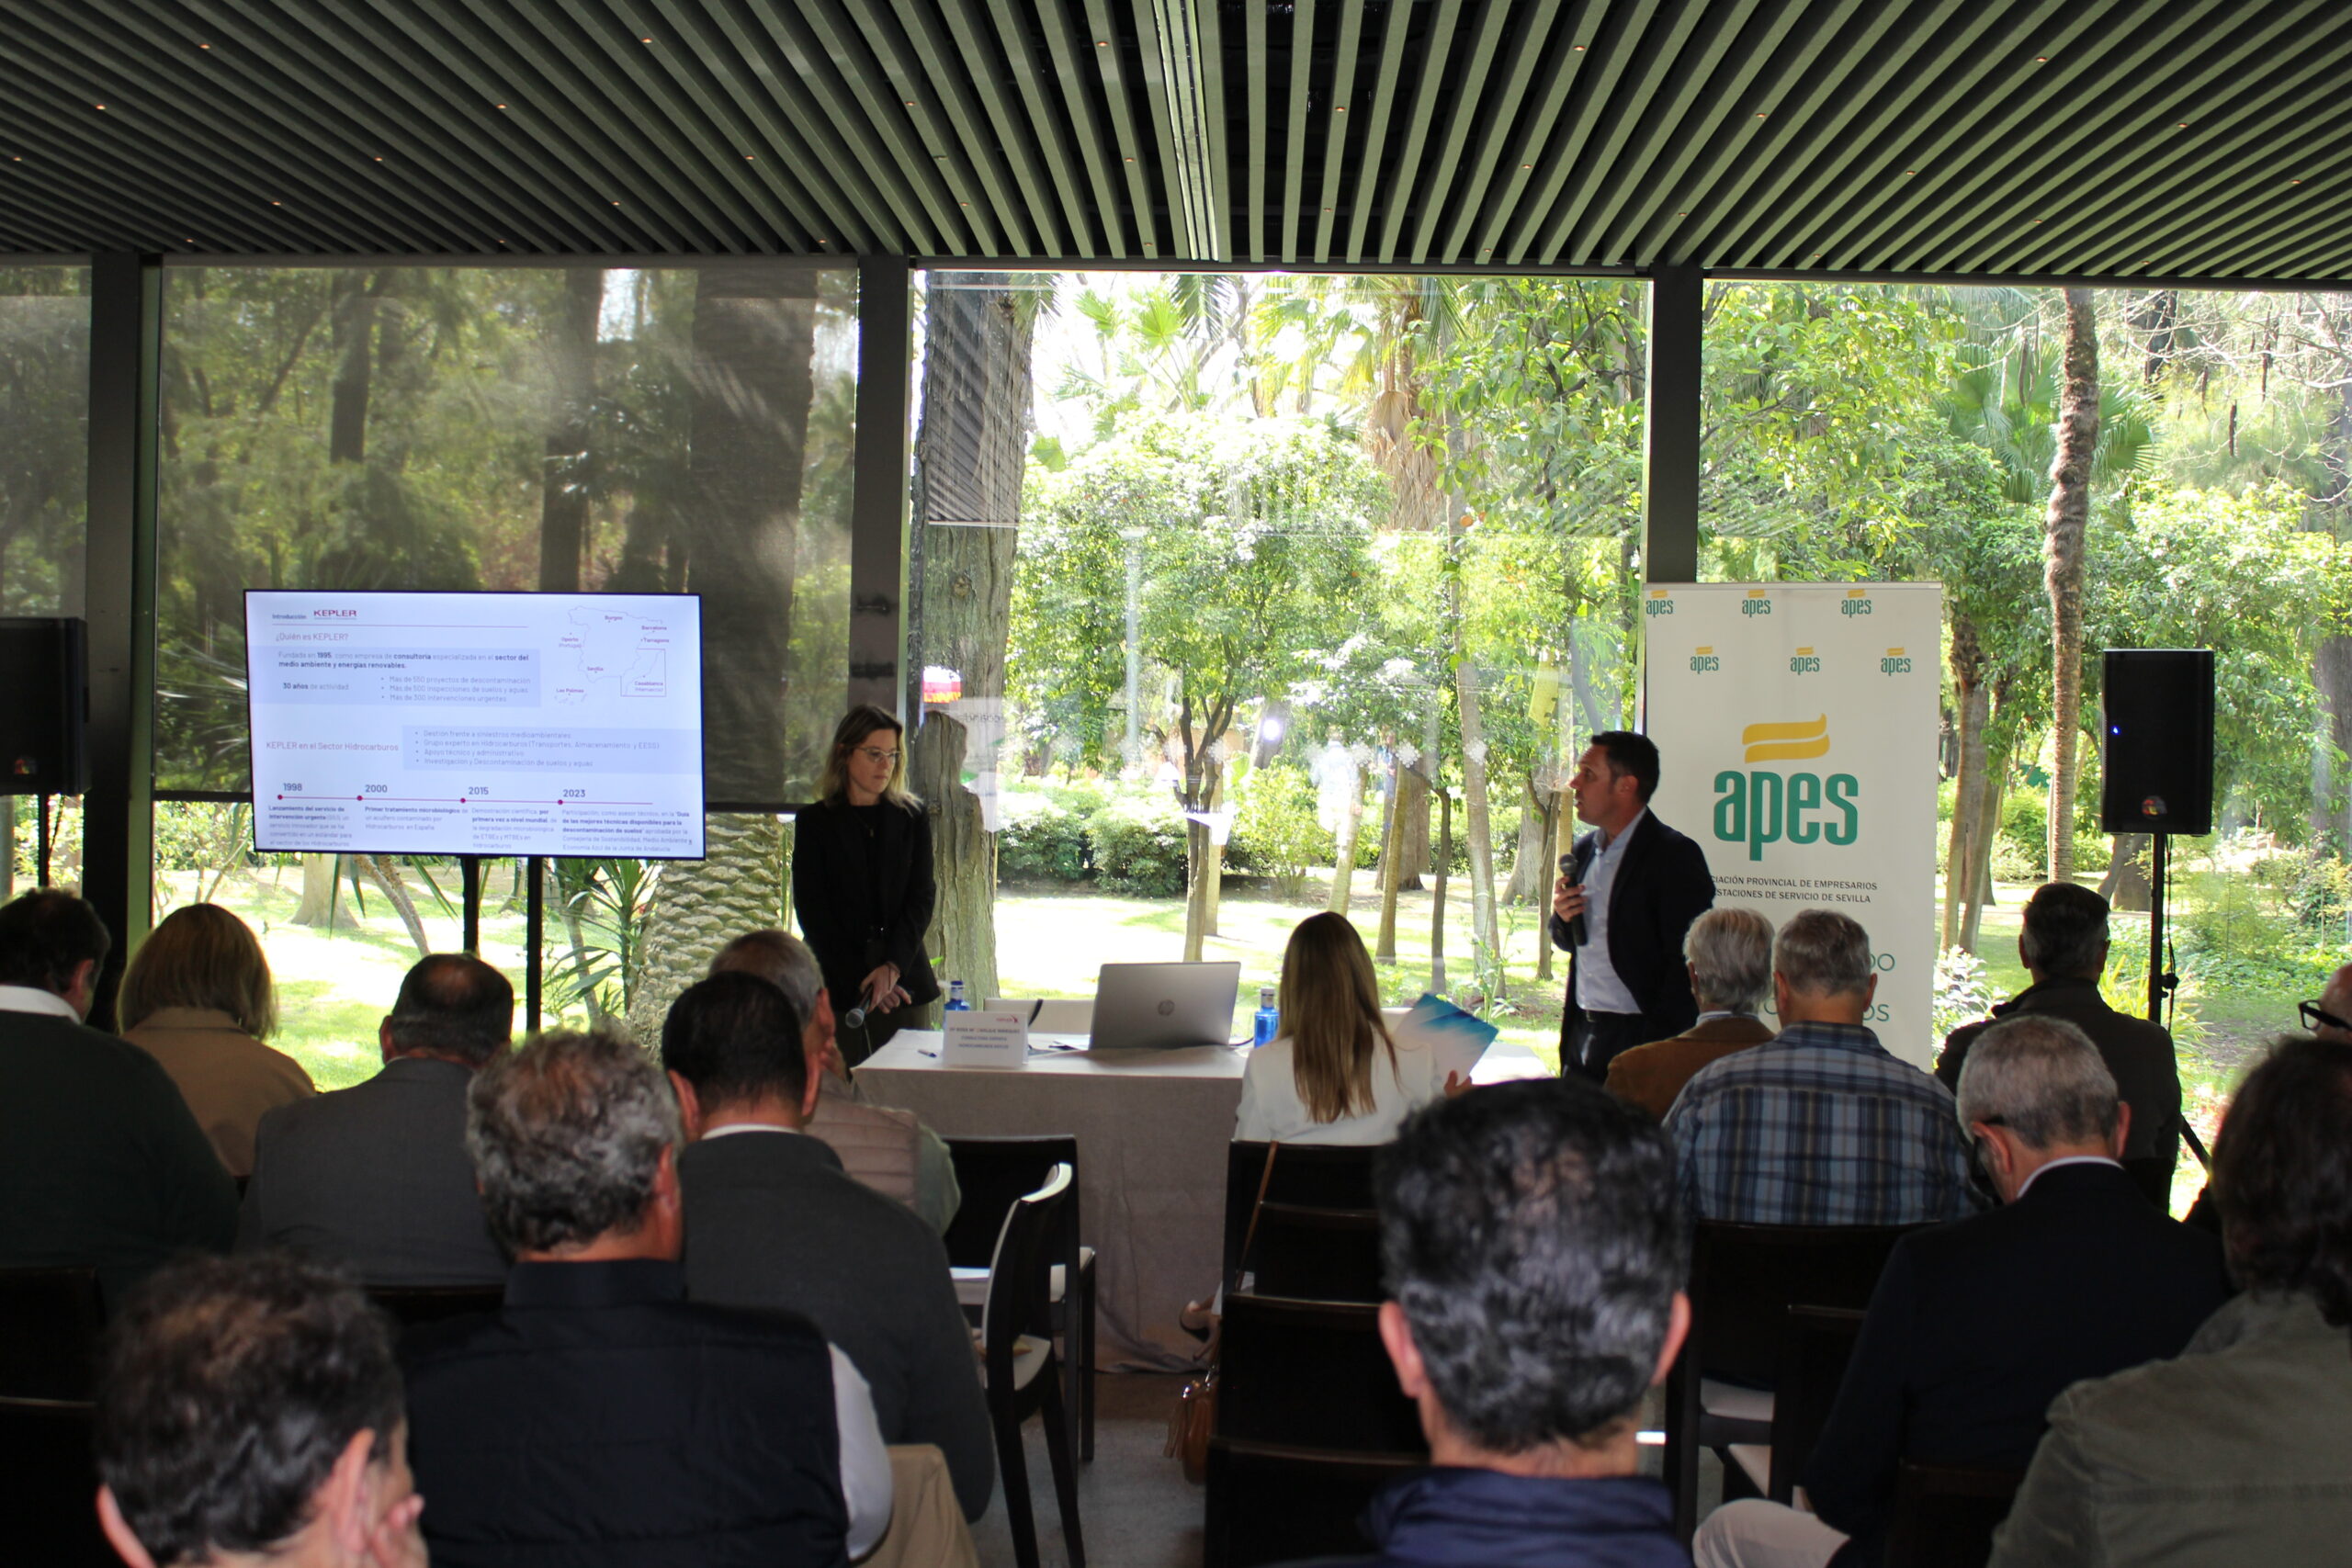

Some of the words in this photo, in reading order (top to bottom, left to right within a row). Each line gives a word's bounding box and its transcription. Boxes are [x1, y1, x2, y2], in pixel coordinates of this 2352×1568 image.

[313, 609, 357, 617] KEPLER
[1645, 600, 1674, 618] apes
[1742, 600, 1771, 618] apes
[1841, 600, 1871, 618] apes
[313, 632, 349, 641] KEPLER?
[433, 653, 477, 661] especializada
[1690, 656, 1719, 674] apes
[1790, 657, 1820, 675] apes
[1880, 657, 1911, 676] apes
[427, 685, 470, 694] inspecciones
[266, 741, 298, 750] KEPLER
[310, 742, 317, 750] el
[318, 742, 343, 750] Sector
[345, 742, 399, 751] Hidrocarburos
[283, 783, 303, 792] 1998
[365, 784, 389, 793] 2000
[469, 786, 490, 795] 2015
[562, 789, 586, 797] 2023
[1713, 770, 1859, 862] apes
[1711, 874, 1744, 886] CIACIÓN
[1747, 877, 1797, 887] PROVINCIAL
[1800, 879, 1812, 888] DE
[1814, 880, 1878, 891] EMPRESARIOS
[1715, 888, 1763, 898] STACIONES
[1765, 890, 1777, 899] DE
[1779, 891, 1819, 901] SERVICIO
[1822, 893, 1834, 902] DE
[1836, 894, 1871, 904] SEVILLA
